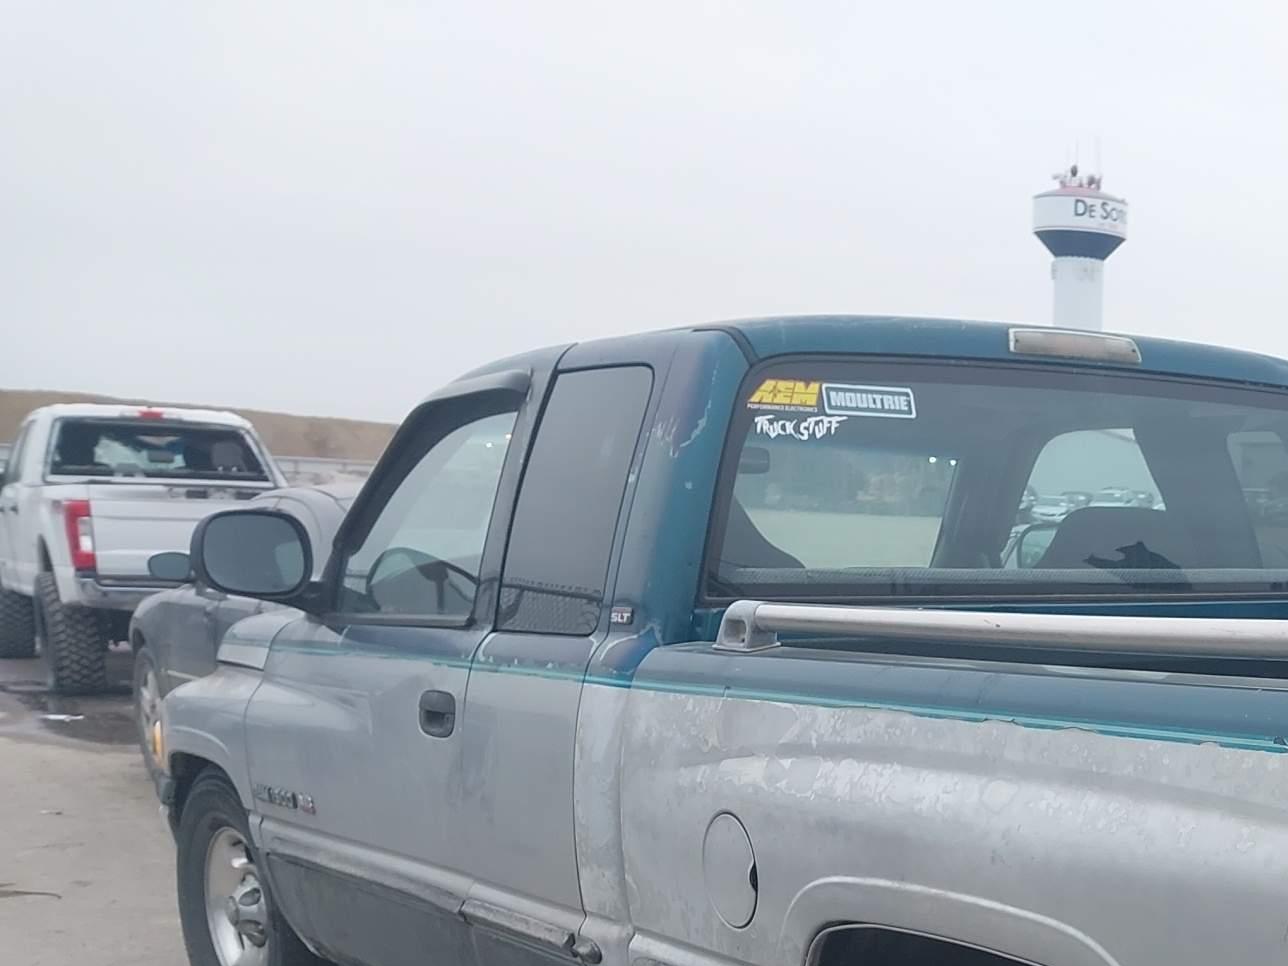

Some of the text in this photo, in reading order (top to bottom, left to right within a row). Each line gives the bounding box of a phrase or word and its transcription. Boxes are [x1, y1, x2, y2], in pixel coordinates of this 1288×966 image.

[748, 379, 820, 406] AEM
[830, 391, 910, 411] MOULTRIE
[754, 414, 849, 441] TRUCK STUFF
[610, 612, 632, 623] SLT
